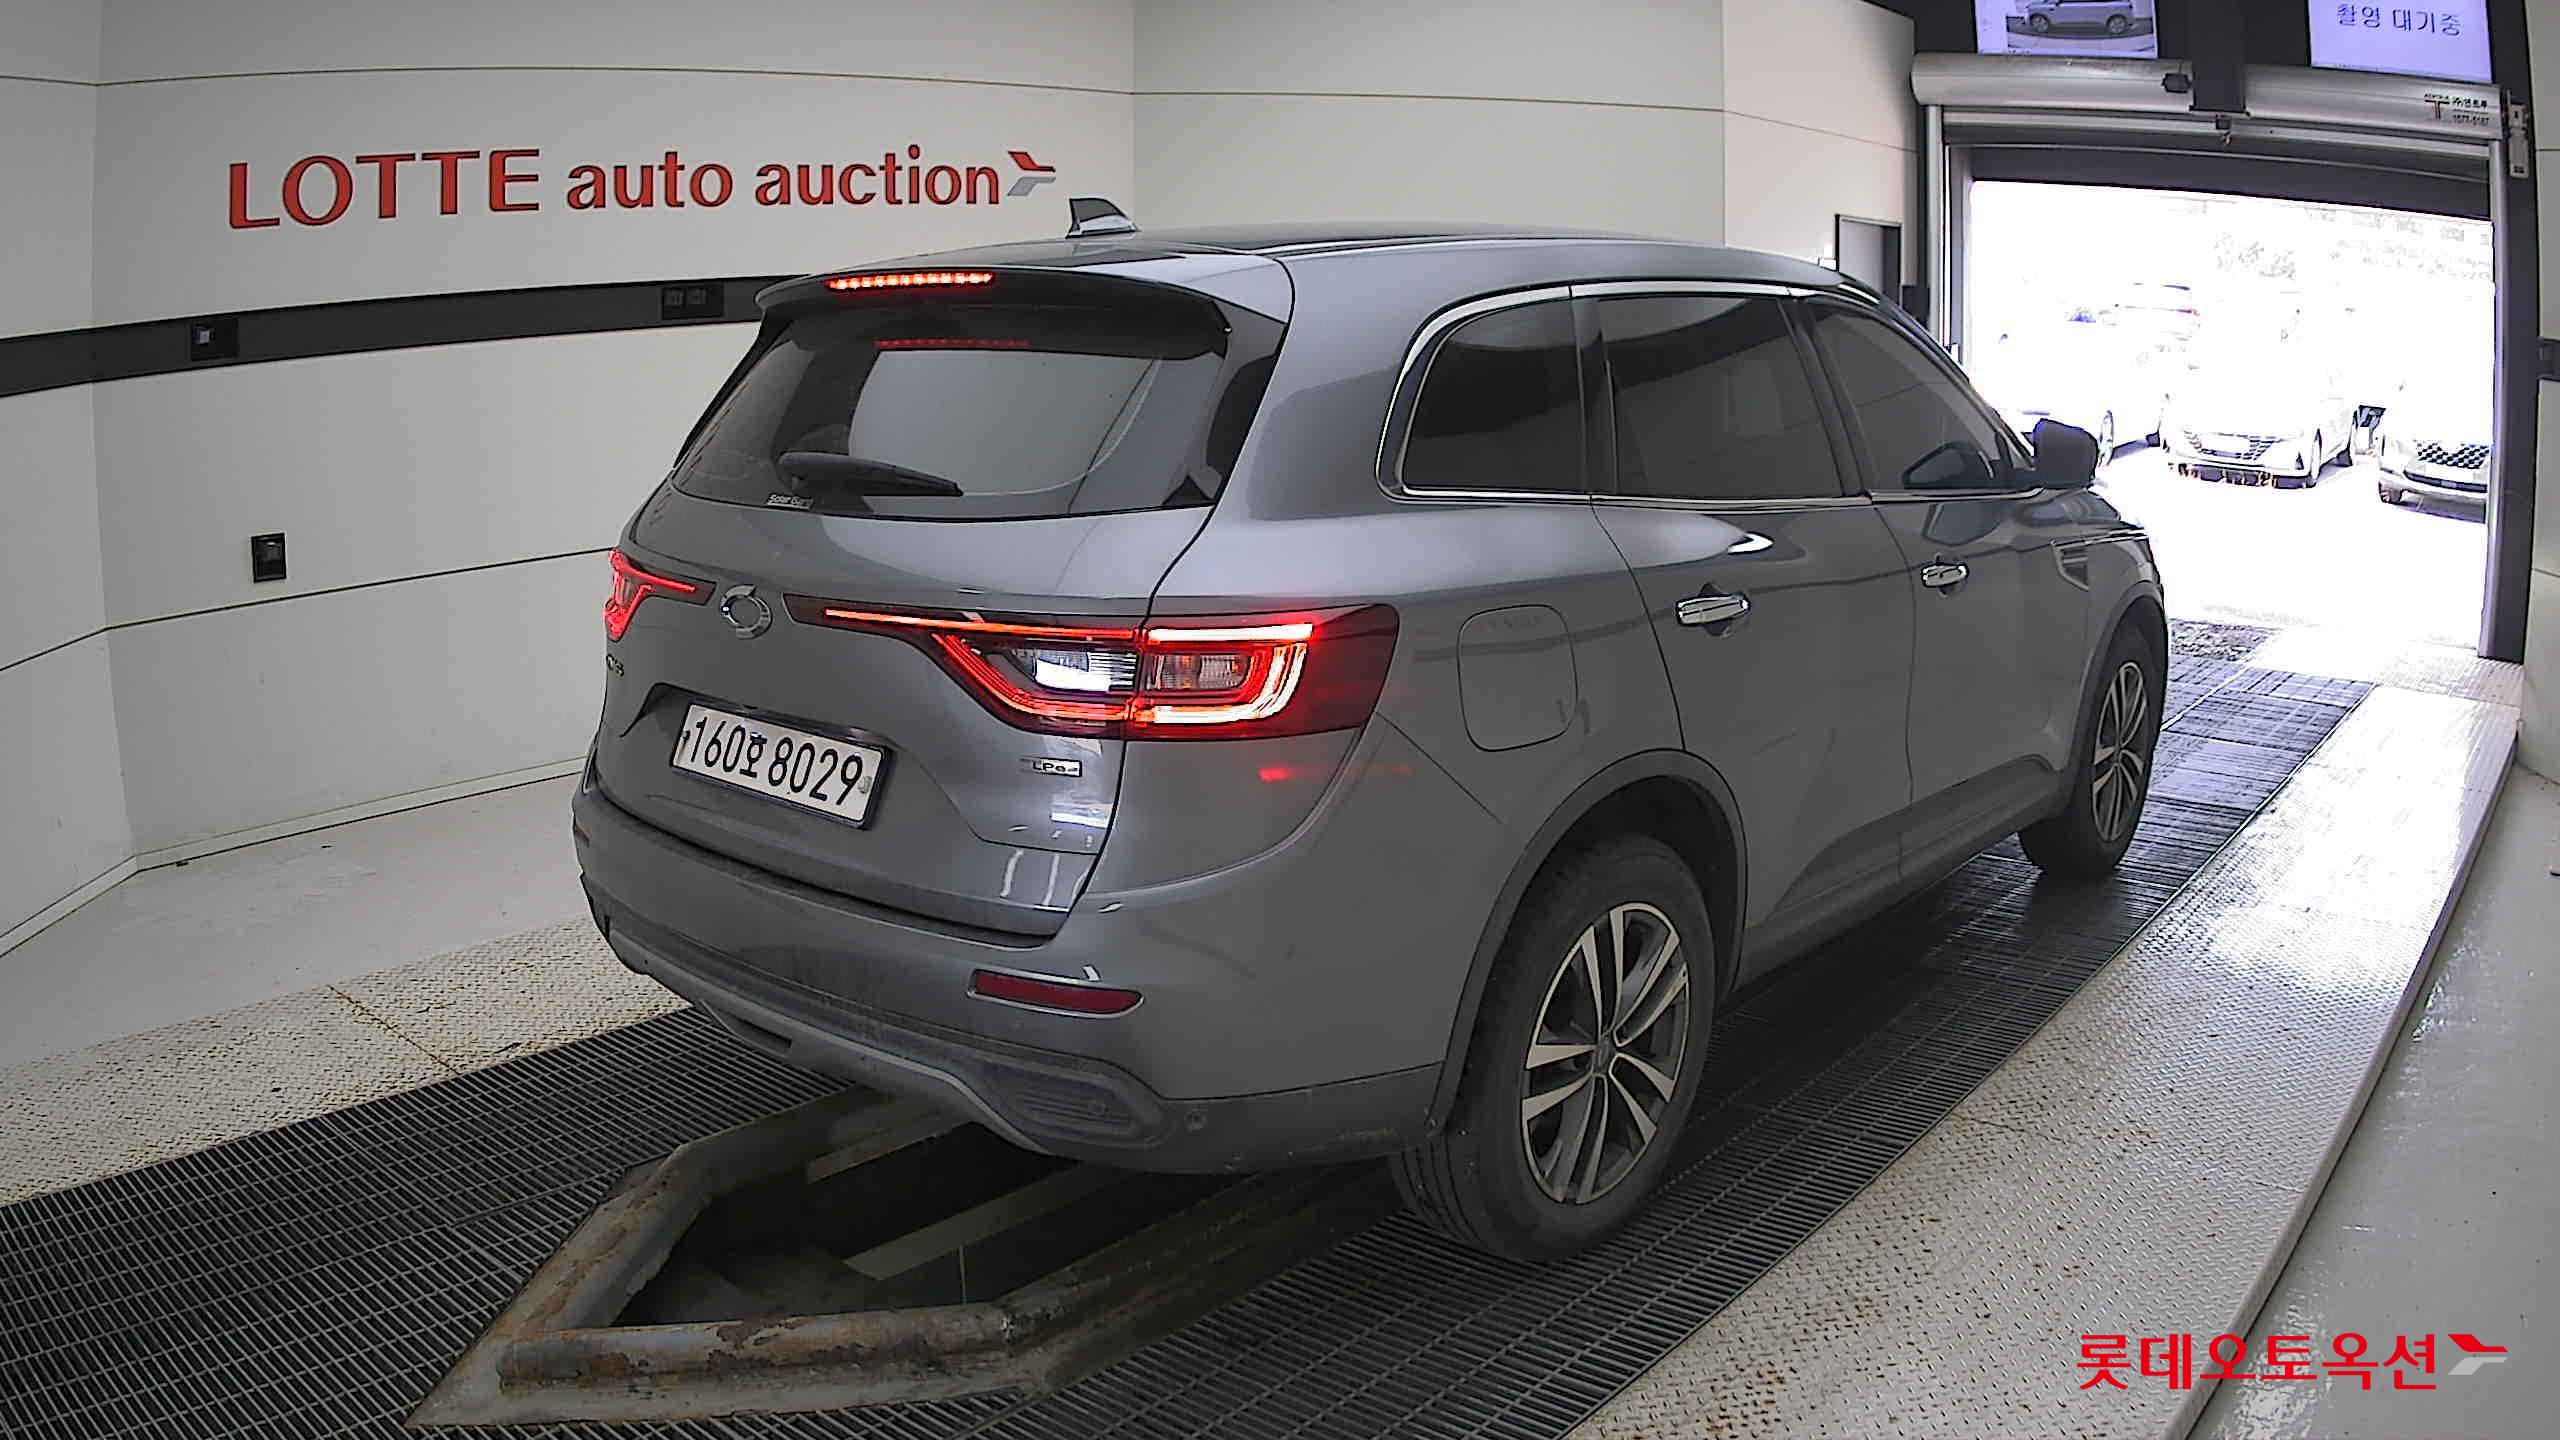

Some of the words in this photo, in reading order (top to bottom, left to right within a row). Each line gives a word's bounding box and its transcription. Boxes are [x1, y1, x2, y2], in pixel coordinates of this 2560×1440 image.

[2392, 9, 2461, 36] 대기중
[228, 147, 541, 231] LOTTE
[566, 150, 734, 210] auto
[754, 144, 1002, 207] auction
